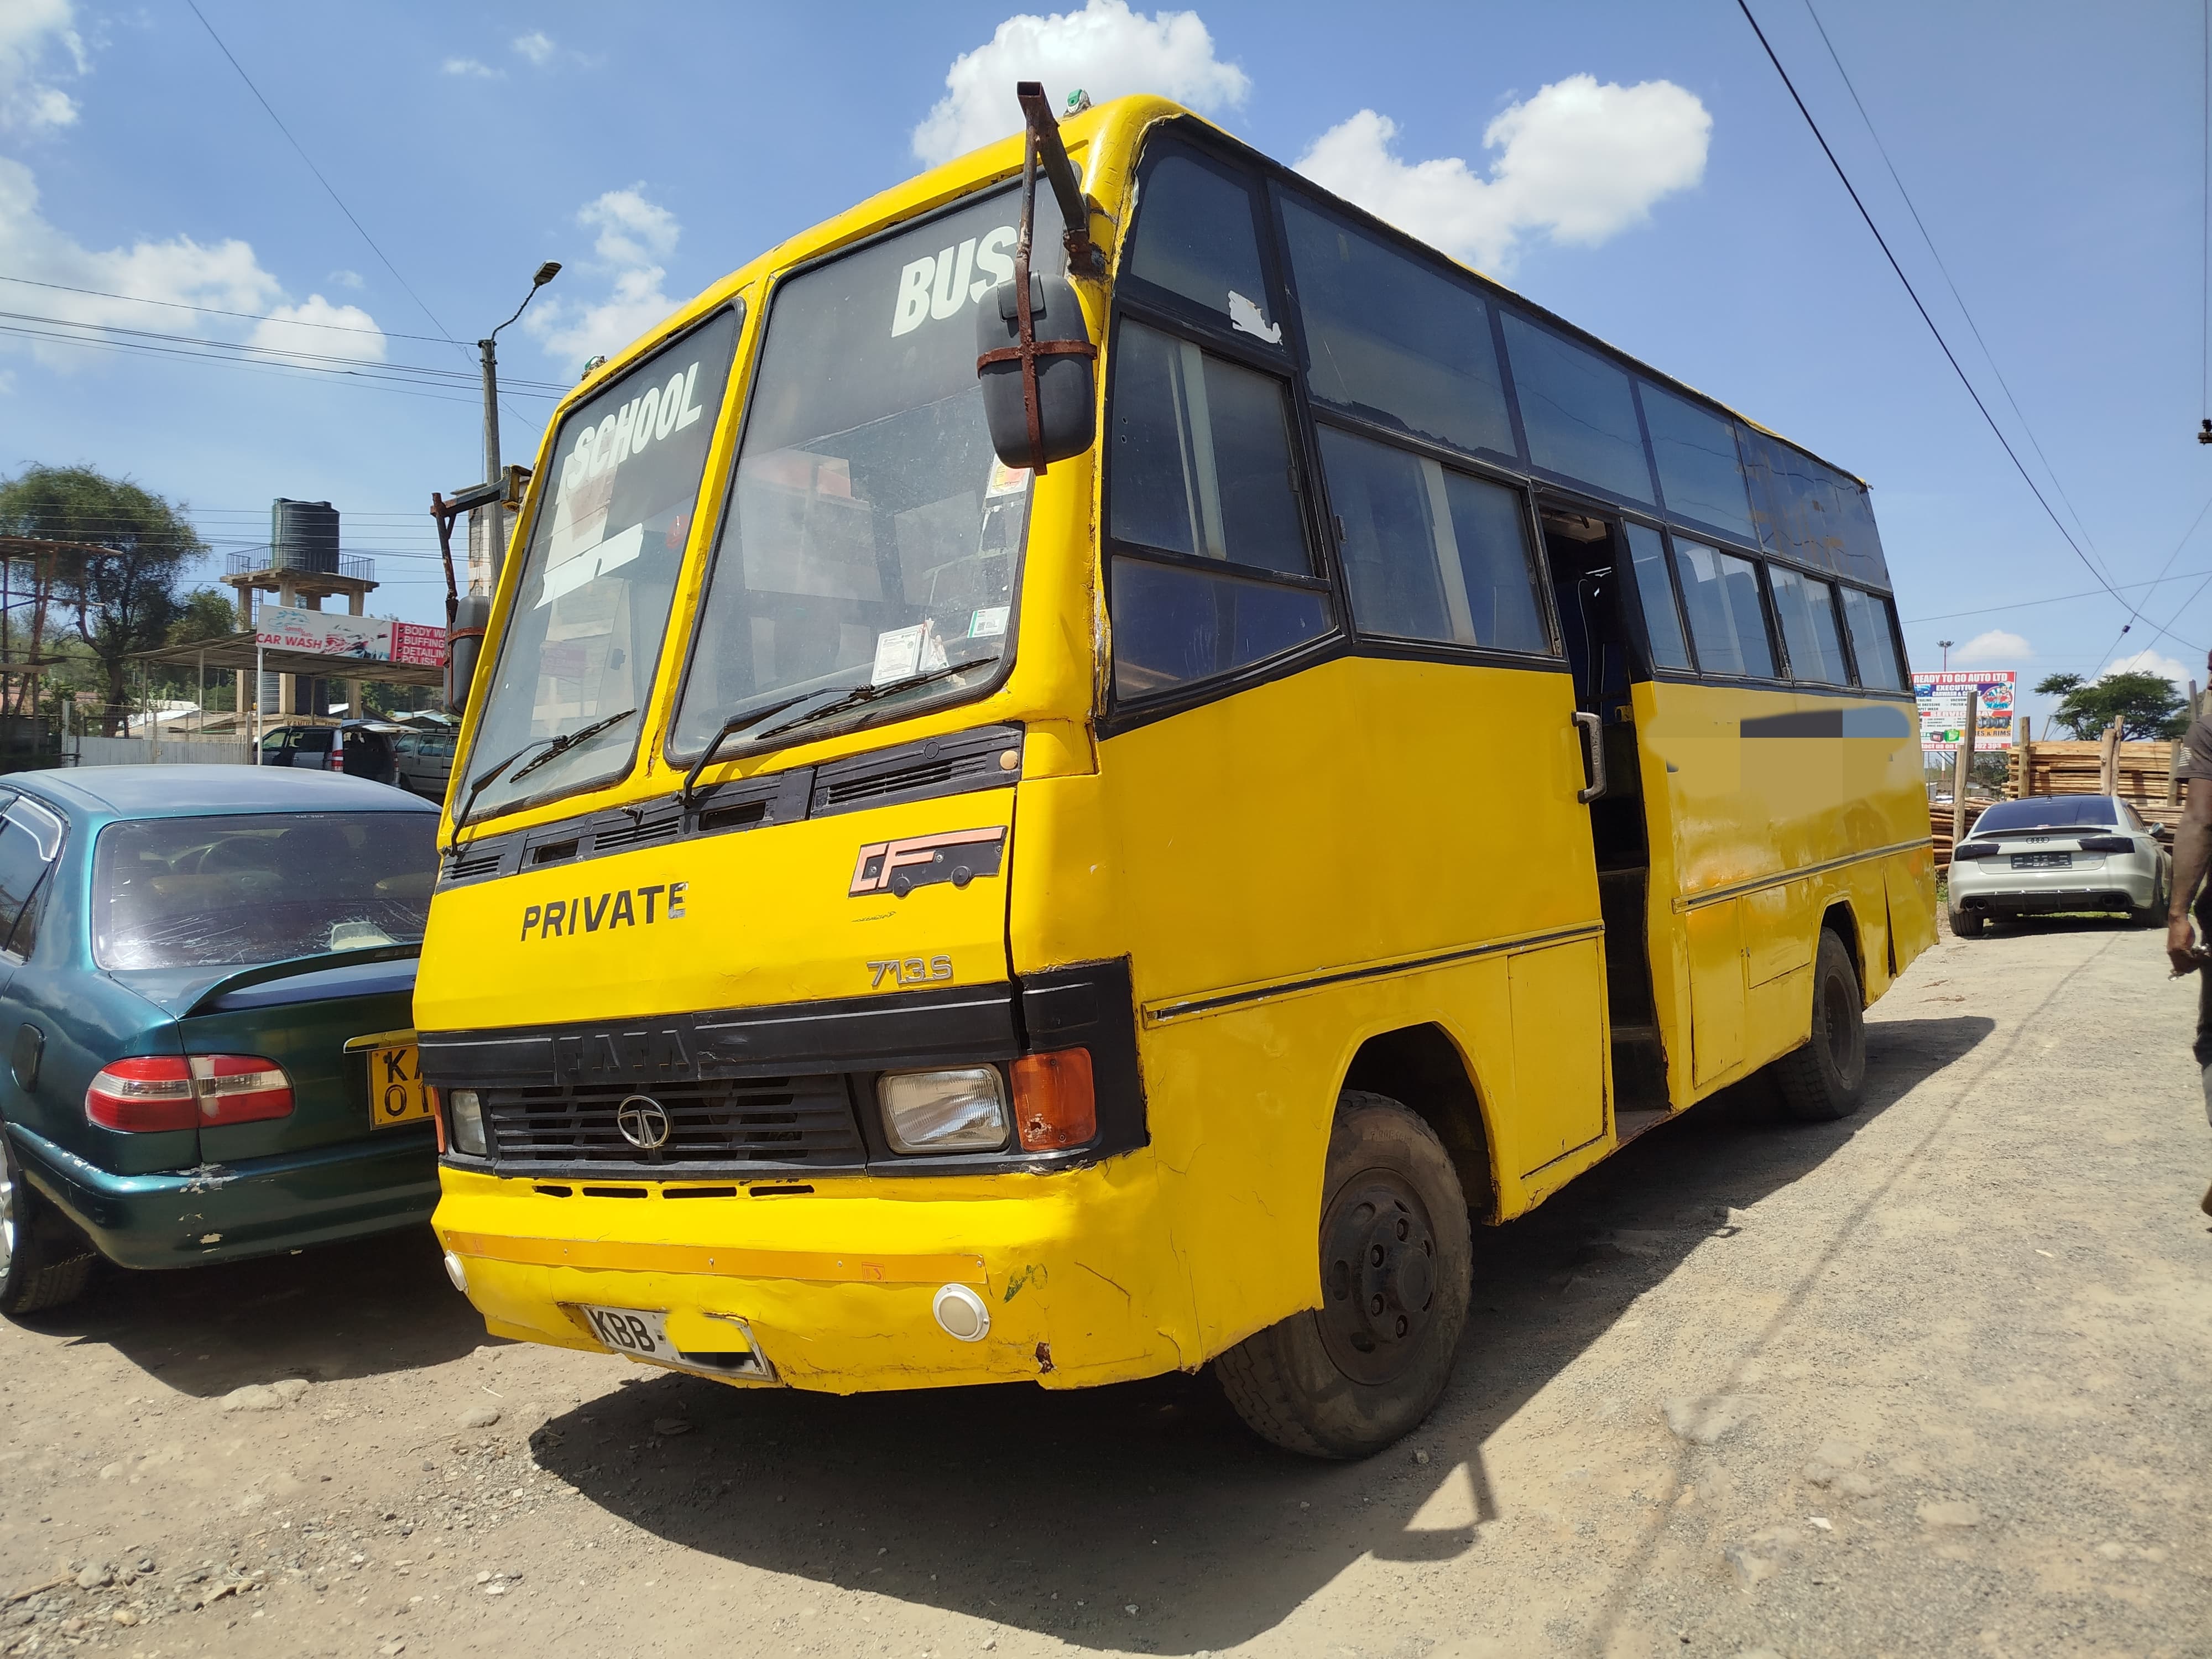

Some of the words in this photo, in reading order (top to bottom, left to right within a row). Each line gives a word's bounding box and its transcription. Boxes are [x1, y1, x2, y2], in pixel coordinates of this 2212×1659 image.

[891, 226, 1018, 337] BUS
[566, 361, 703, 490] SCHOOL
[404, 625, 434, 637] BODY
[434, 629, 446, 638] WA
[256, 633, 281, 644] CAR
[285, 637, 323, 649] WASH
[404, 635, 445, 648] BUFFING
[403, 646, 445, 658] DETAILIN
[401, 655, 437, 666] POLISH
[1914, 674, 1940, 683] READY
[1942, 674, 1953, 682] TO
[1954, 674, 1966, 682] GO
[1968, 673, 1991, 682] AUTO
[1992, 672, 2008, 682] LTD
[520, 881, 689, 942] PRIVATE
[557, 1029, 691, 1073] TATA
[588, 1310, 656, 1353] KBB
